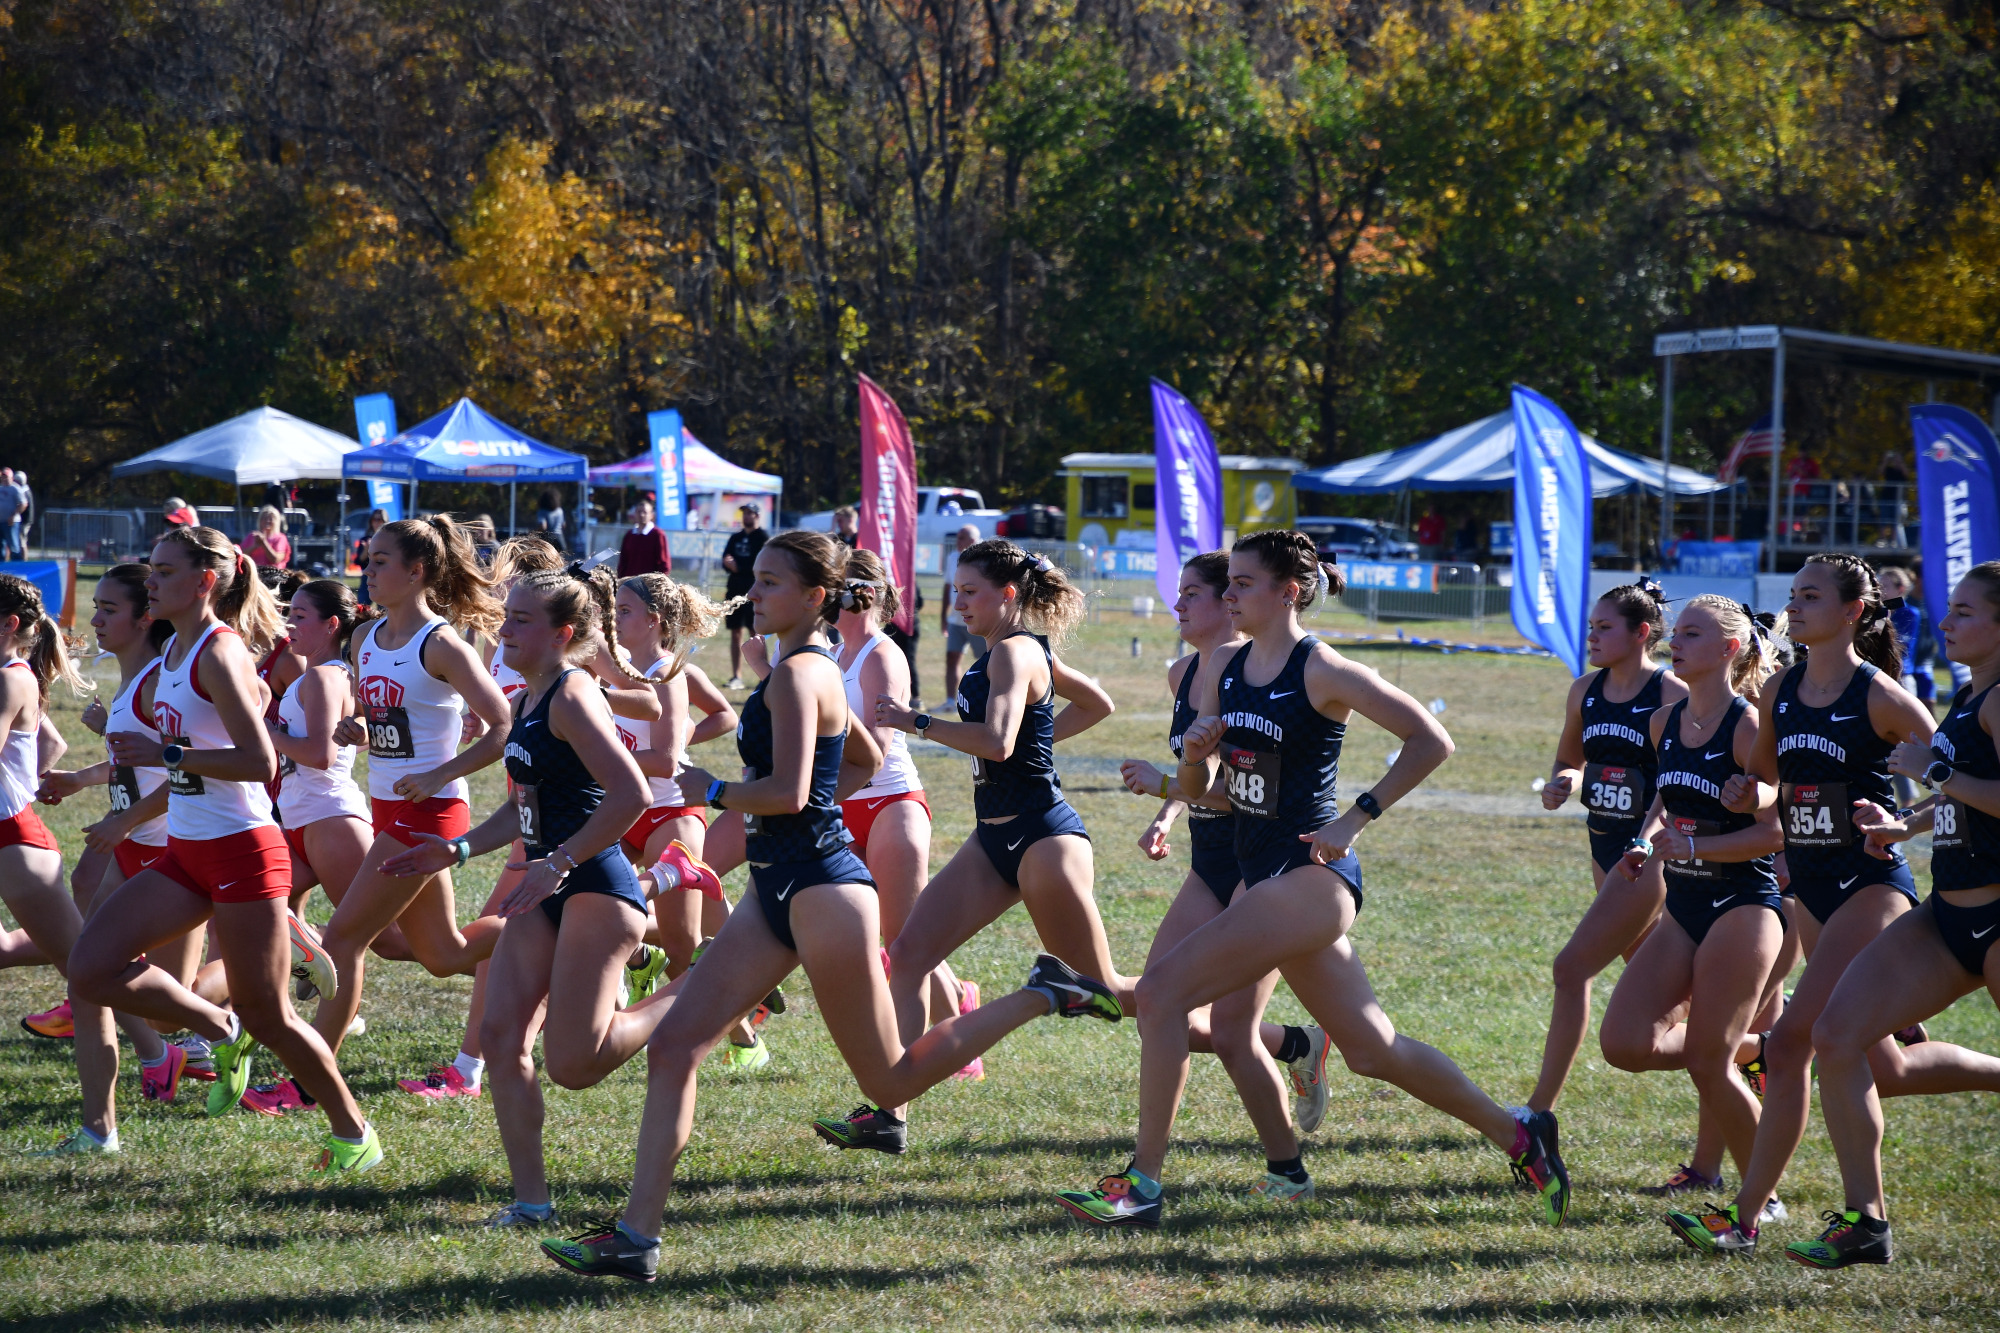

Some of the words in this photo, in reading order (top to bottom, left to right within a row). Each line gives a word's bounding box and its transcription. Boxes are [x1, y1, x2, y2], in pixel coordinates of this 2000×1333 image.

[441, 439, 532, 457] SOUTH
[1351, 564, 1398, 587] HYPE
[368, 723, 401, 749] 389
[1221, 712, 1283, 743] ONGWOOD
[1777, 733, 1846, 764] LONGWOOD
[1228, 766, 1265, 804] 348
[1590, 782, 1633, 811] 356
[518, 804, 534, 835] 52
[1789, 805, 1834, 835] 354
